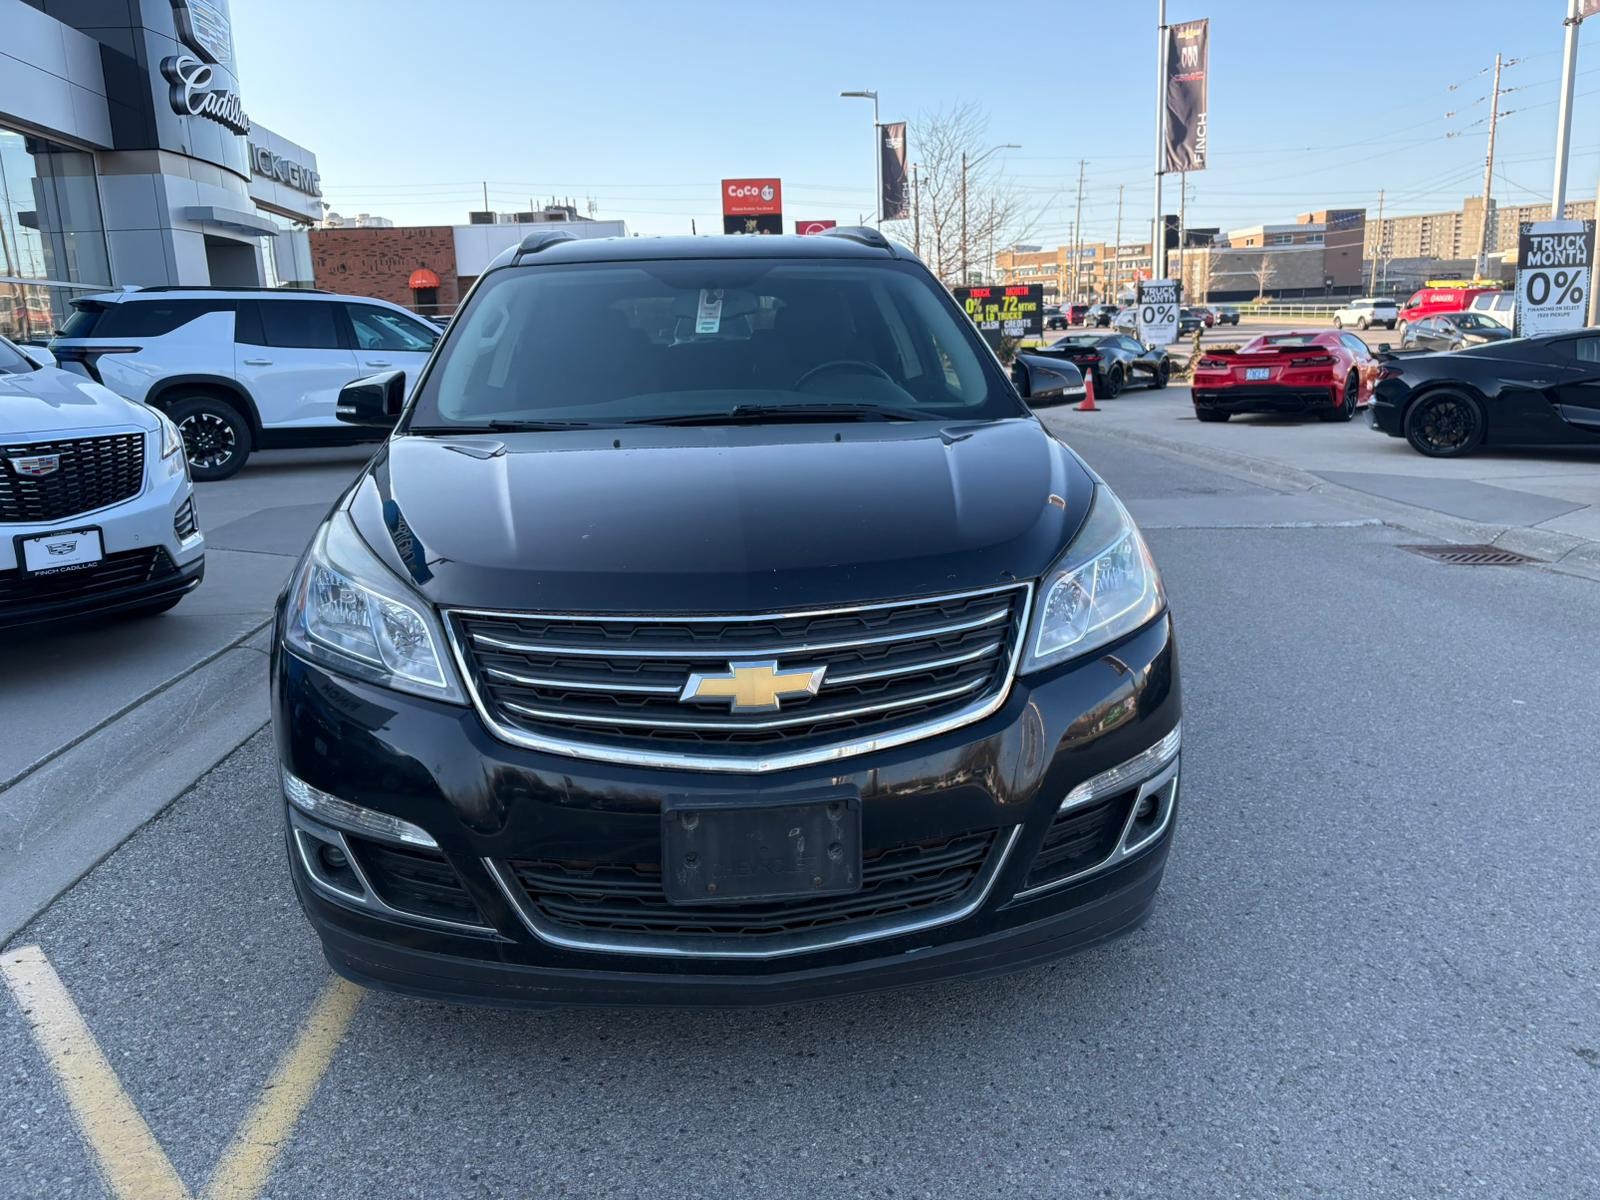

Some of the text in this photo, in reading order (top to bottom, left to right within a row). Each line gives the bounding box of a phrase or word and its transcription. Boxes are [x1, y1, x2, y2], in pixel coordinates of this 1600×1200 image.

[175, 55, 250, 135] Cadillac
[1193, 112, 1207, 164] FINCH
[249, 143, 323, 197] ICK GMC
[728, 185, 758, 197] CoCo
[1530, 235, 1586, 252] TRUCK
[1527, 249, 1587, 266] MONTH
[970, 287, 1029, 297] TRUCK MONTH
[1142, 287, 1176, 297] TRUCK
[1526, 270, 1583, 305] 0%
[965, 298, 982, 314] 0%
[986, 304, 999, 312] FOR
[1002, 296, 1018, 312] 72
[1141, 294, 1176, 303] MONTH
[997, 311, 1023, 320] TRUCKS
[1142, 305, 1175, 324] 0%
[1003, 319, 1032, 328] CREDITS
[60, 562, 98, 573] CADILLAC
